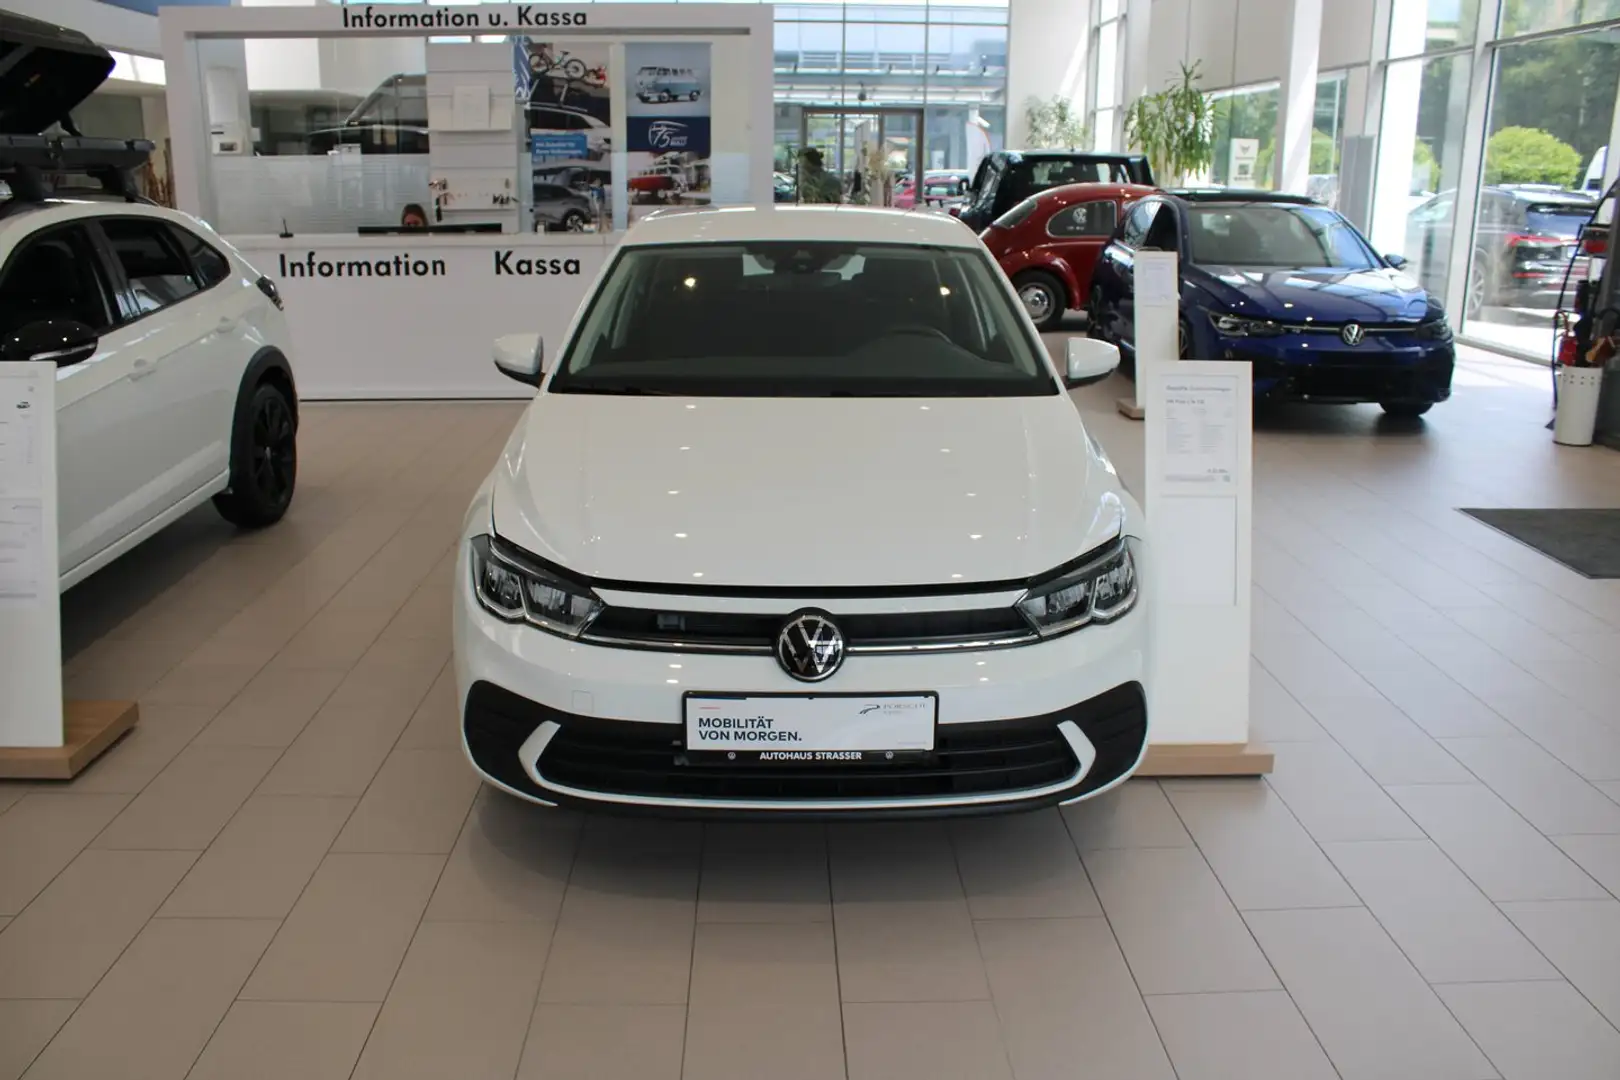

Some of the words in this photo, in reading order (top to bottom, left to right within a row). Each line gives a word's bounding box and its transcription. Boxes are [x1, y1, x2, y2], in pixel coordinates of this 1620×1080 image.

[343, 7, 480, 28] Information
[488, 15, 508, 27] u.
[517, 5, 587, 26] Kassa
[279, 251, 446, 278] Information
[494, 250, 581, 276] Kassa
[698, 715, 774, 729] MOBILITÄT
[699, 730, 730, 741] VON
[734, 730, 802, 741] MORGEN.
[759, 751, 813, 760] AUTOHAUS
[815, 751, 862, 760] STRASSER
